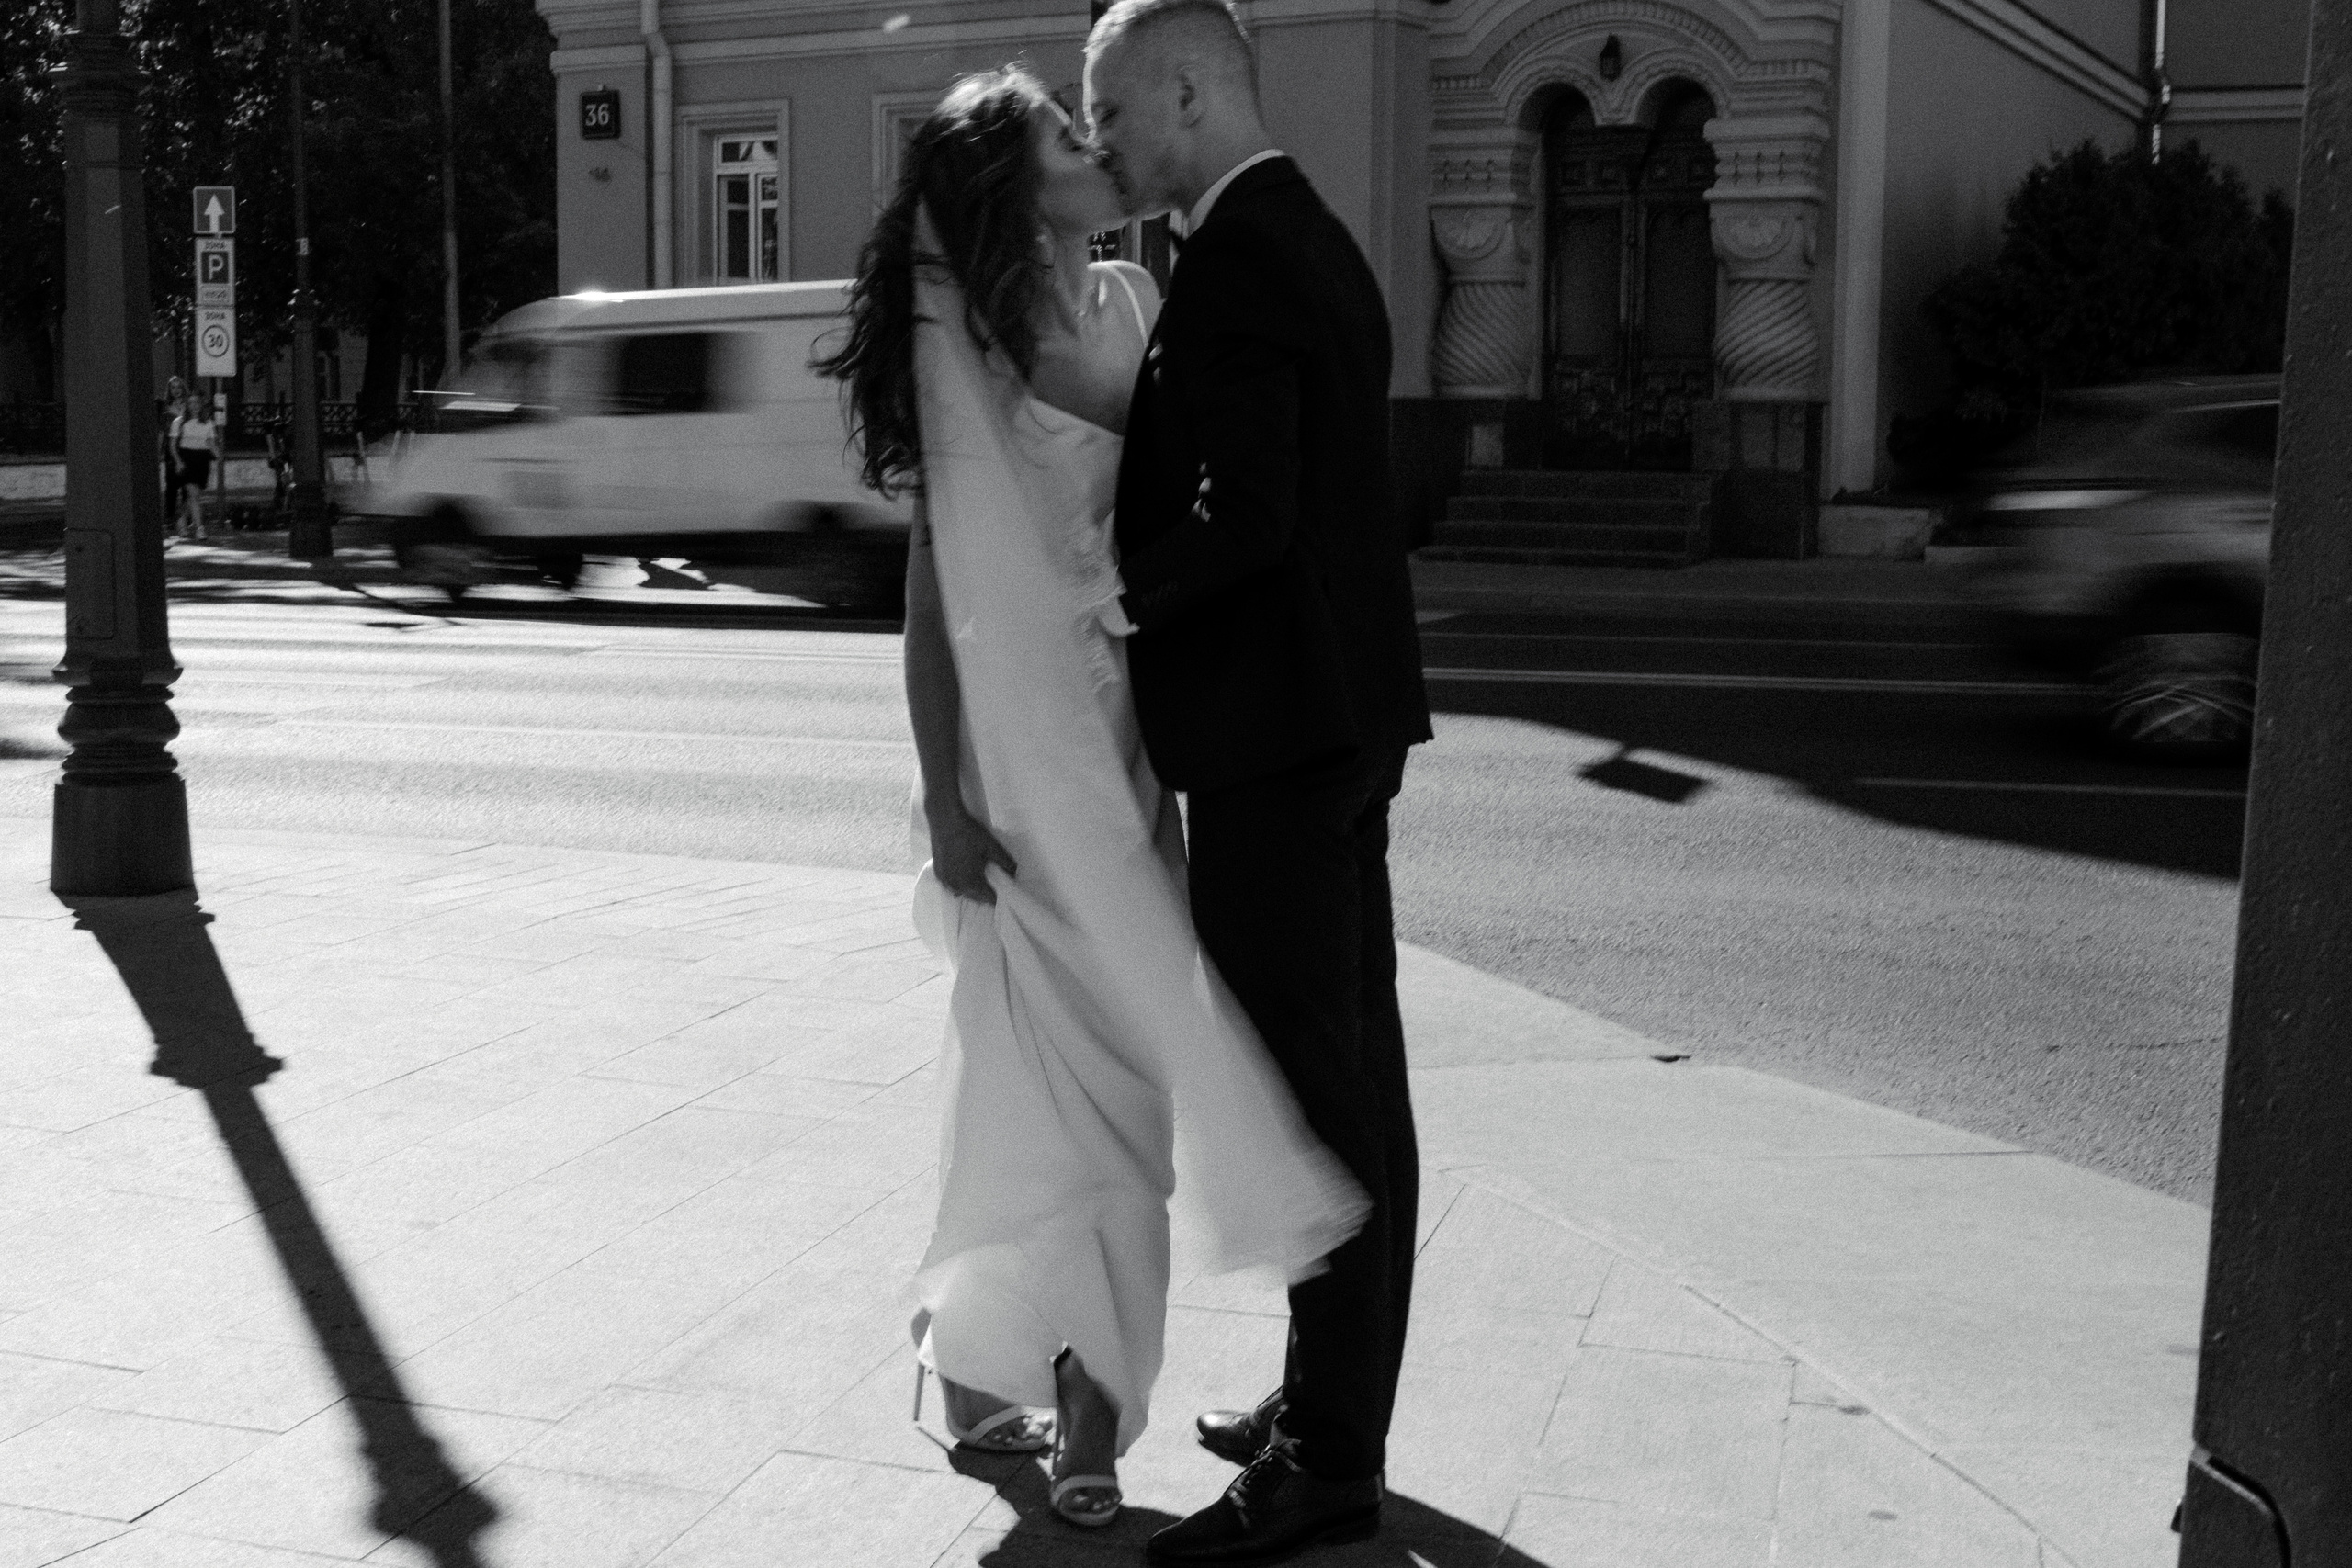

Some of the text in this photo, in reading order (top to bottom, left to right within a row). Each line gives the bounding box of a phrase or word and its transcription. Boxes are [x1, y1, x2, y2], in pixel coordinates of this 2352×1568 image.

[585, 103, 609, 126] 36
[209, 254, 224, 280] P
[208, 334, 224, 348] 30
